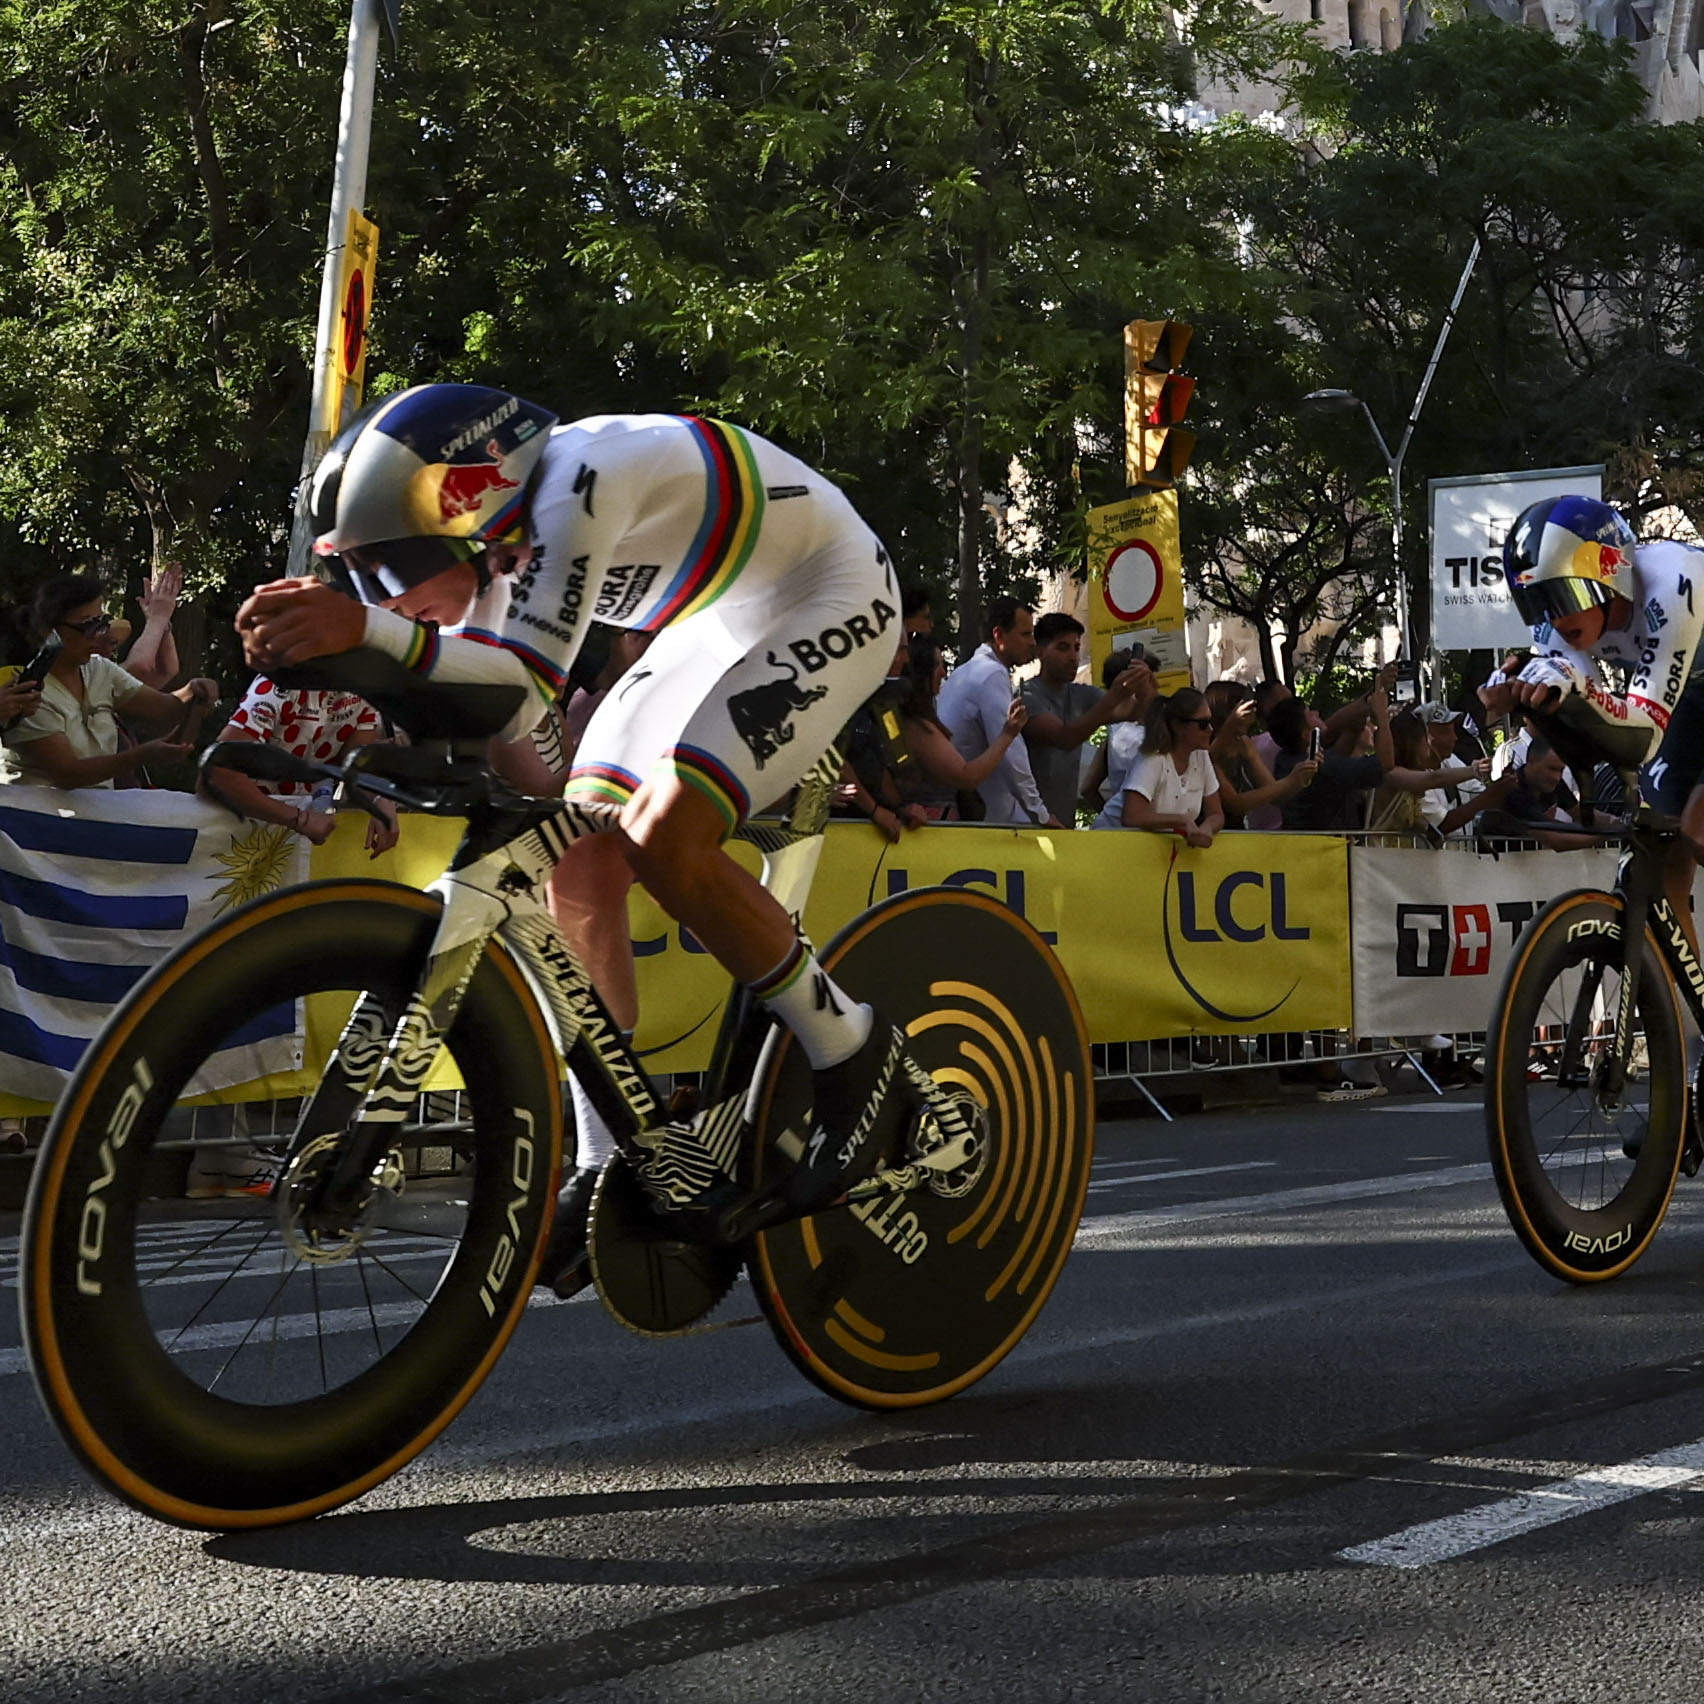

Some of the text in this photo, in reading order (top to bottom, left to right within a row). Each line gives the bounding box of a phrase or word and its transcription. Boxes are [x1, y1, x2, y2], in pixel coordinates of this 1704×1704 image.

[558, 554, 590, 626] BORA
[1444, 596, 1474, 606] SWISS
[788, 598, 896, 673] BORA
[1664, 650, 1686, 708] BORA
[1177, 871, 1310, 943] LCL
[534, 933, 657, 1125] SPECIALIZED
[77, 1056, 155, 1296] roval
[479, 1107, 535, 1319] roval
[1563, 1223, 1633, 1255] roval
